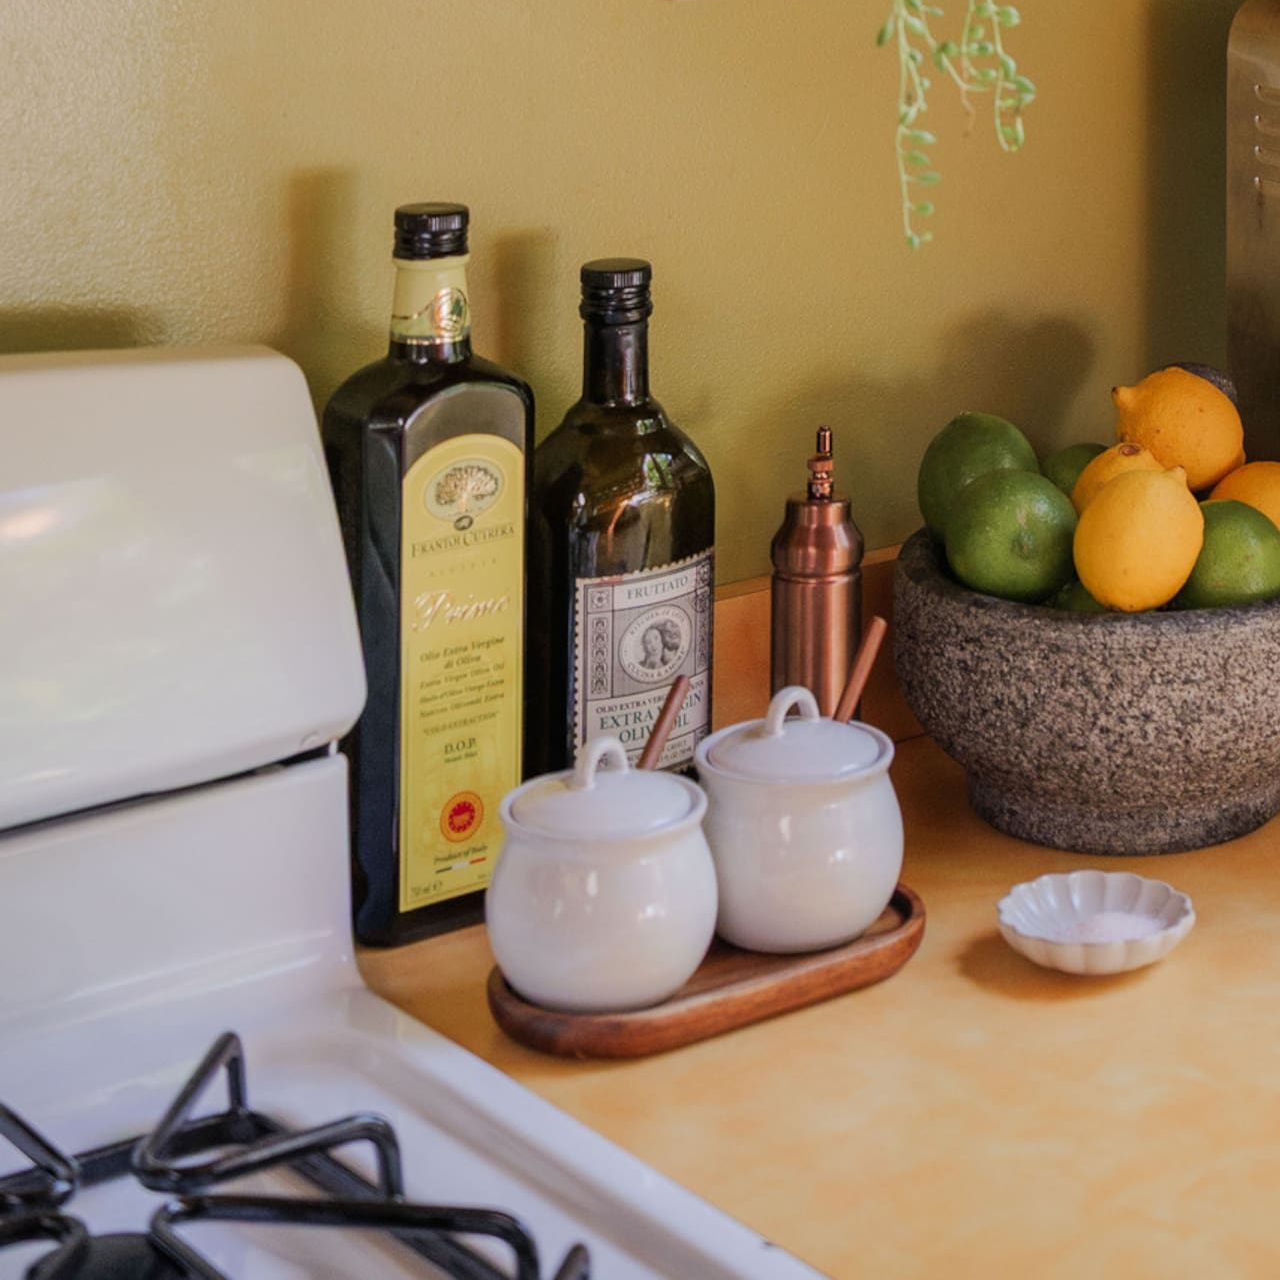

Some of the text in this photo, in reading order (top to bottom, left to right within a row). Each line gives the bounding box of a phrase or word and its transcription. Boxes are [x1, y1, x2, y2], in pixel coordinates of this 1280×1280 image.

[626, 575, 689, 600] FRUTTATO
[599, 710, 654, 731] EXTRA
[618, 725, 654, 743] OLIV
